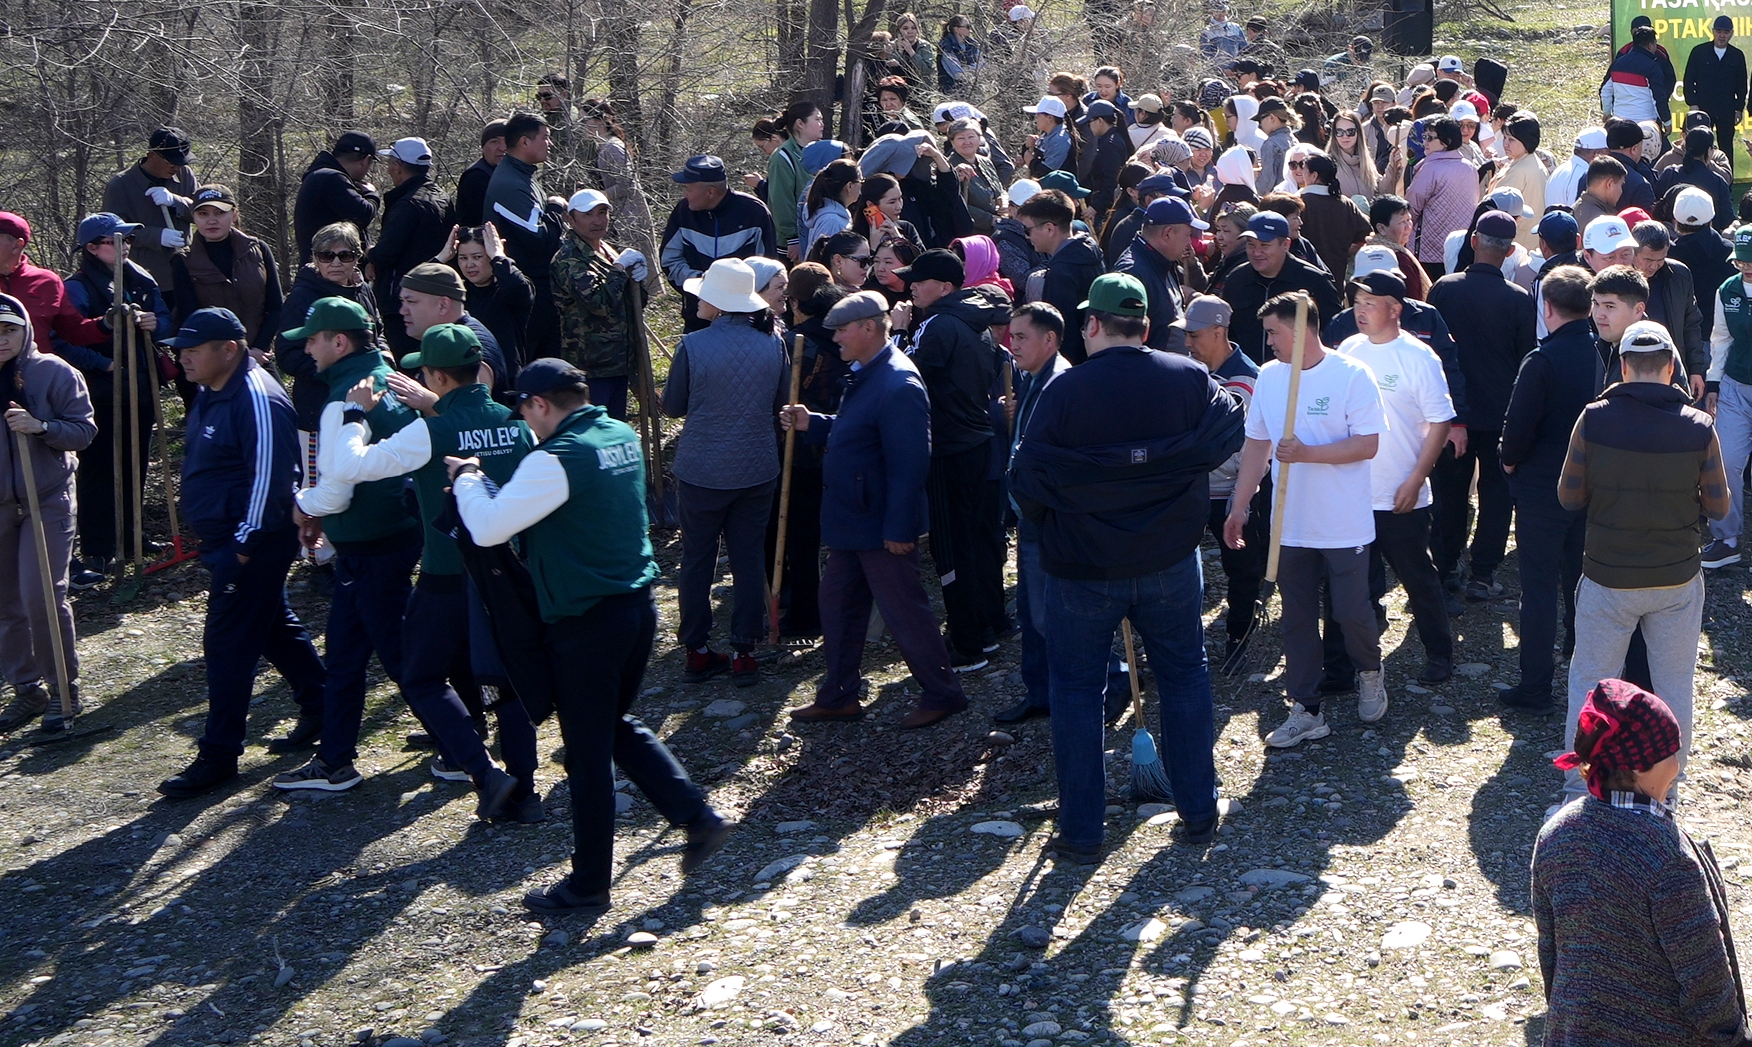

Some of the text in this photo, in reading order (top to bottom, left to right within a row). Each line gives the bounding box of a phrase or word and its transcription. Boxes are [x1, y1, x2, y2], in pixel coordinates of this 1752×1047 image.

[1652, 17, 1714, 42] РТАҚ
[458, 426, 515, 451] JASYL EL
